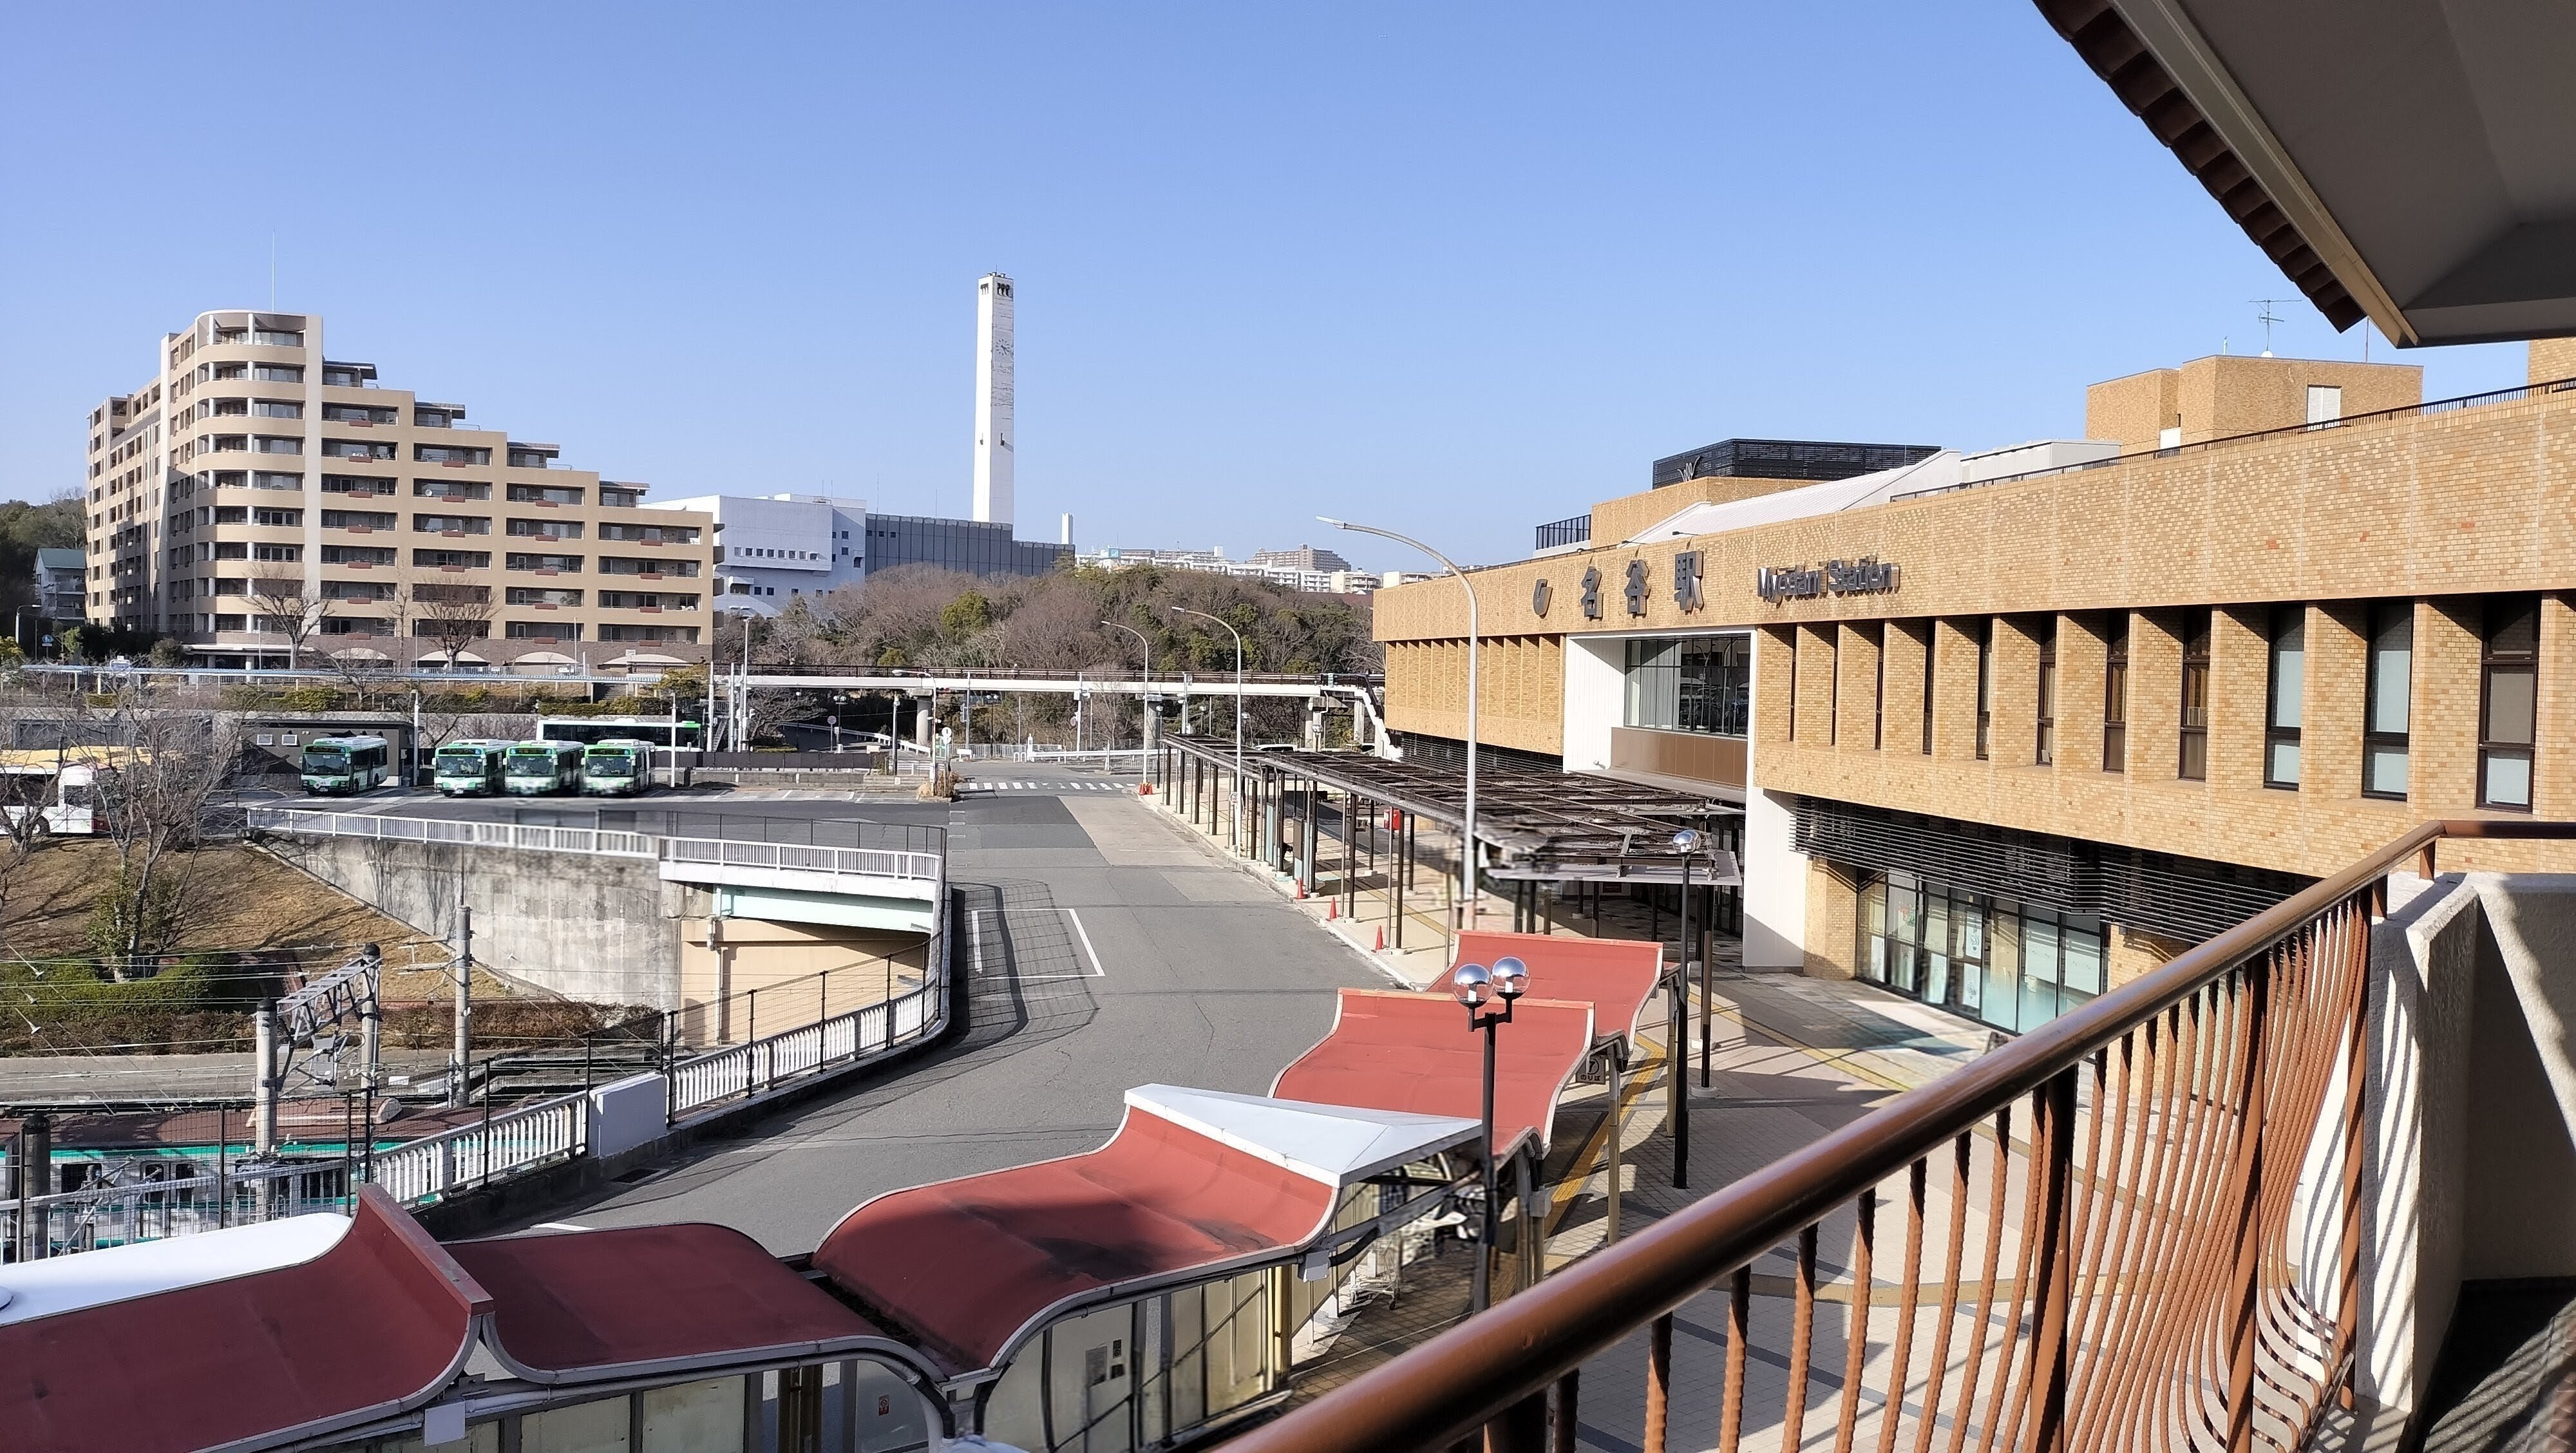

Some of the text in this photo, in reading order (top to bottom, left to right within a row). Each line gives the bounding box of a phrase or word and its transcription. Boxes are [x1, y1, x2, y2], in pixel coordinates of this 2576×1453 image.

[1581, 550, 1703, 618] 名谷駅
[1829, 555, 1899, 592] Station
